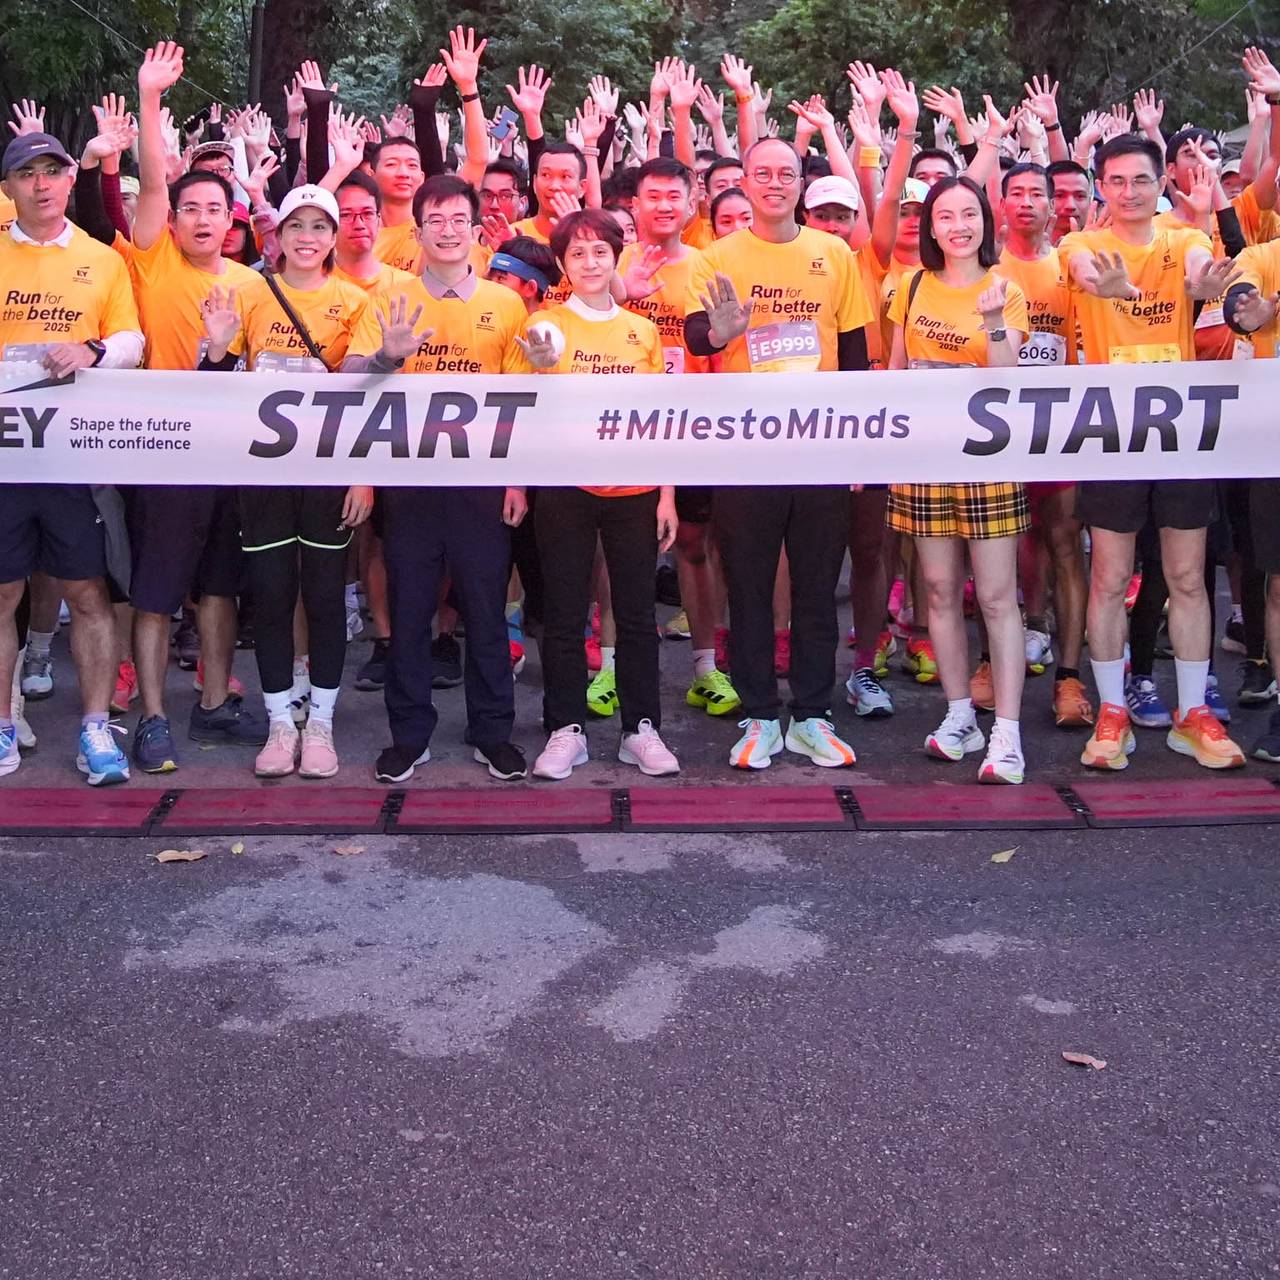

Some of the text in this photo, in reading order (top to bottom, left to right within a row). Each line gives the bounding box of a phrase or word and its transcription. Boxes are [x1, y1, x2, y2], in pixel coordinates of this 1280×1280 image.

[77, 269, 88, 277] EY
[5, 290, 63, 305] Run for
[751, 285, 802, 298] Run for
[1144, 290, 1159, 301] for
[629, 300, 675, 312] Run for
[772, 301, 821, 314] better
[1033, 301, 1048, 310] for
[3, 306, 83, 322] the better
[648, 312, 684, 327] bette
[44, 322, 70, 332] 2025
[915, 315, 956, 330] Run for
[1148, 316, 1172, 326] 2025
[659, 327, 681, 336] 2025
[926, 329, 970, 345] better
[265, 337, 283, 347] the
[760, 336, 815, 356] E9999
[939, 341, 959, 352] 2025
[417, 343, 468, 356] Run for
[1019, 347, 1058, 361] 6063
[574, 351, 618, 362] Run for
[415, 358, 481, 373] the bette
[571, 363, 636, 374] the better
[70, 418, 191, 435] Shape the future
[248, 390, 537, 459] START
[596, 407, 911, 441] #MilestoMinds
[962, 384, 1239, 457] START
[70, 436, 191, 450] with confidence
